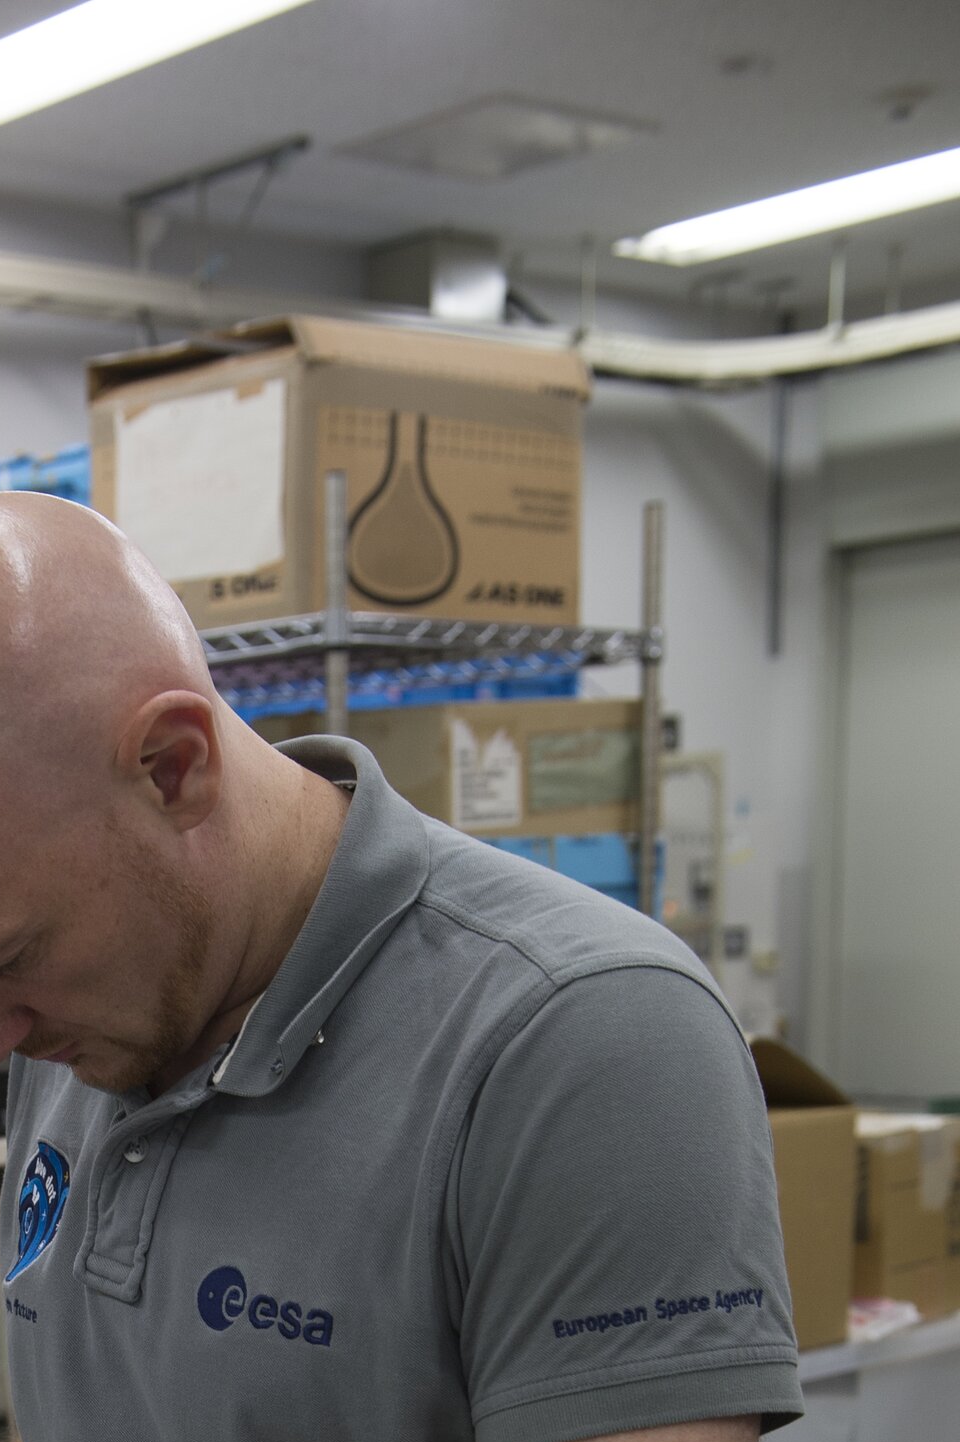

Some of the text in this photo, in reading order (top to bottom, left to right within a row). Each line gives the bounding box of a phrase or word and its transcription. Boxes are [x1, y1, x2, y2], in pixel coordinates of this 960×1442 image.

[13, 1298, 38, 1323] future
[552, 1287, 763, 1338] European Space Agency
